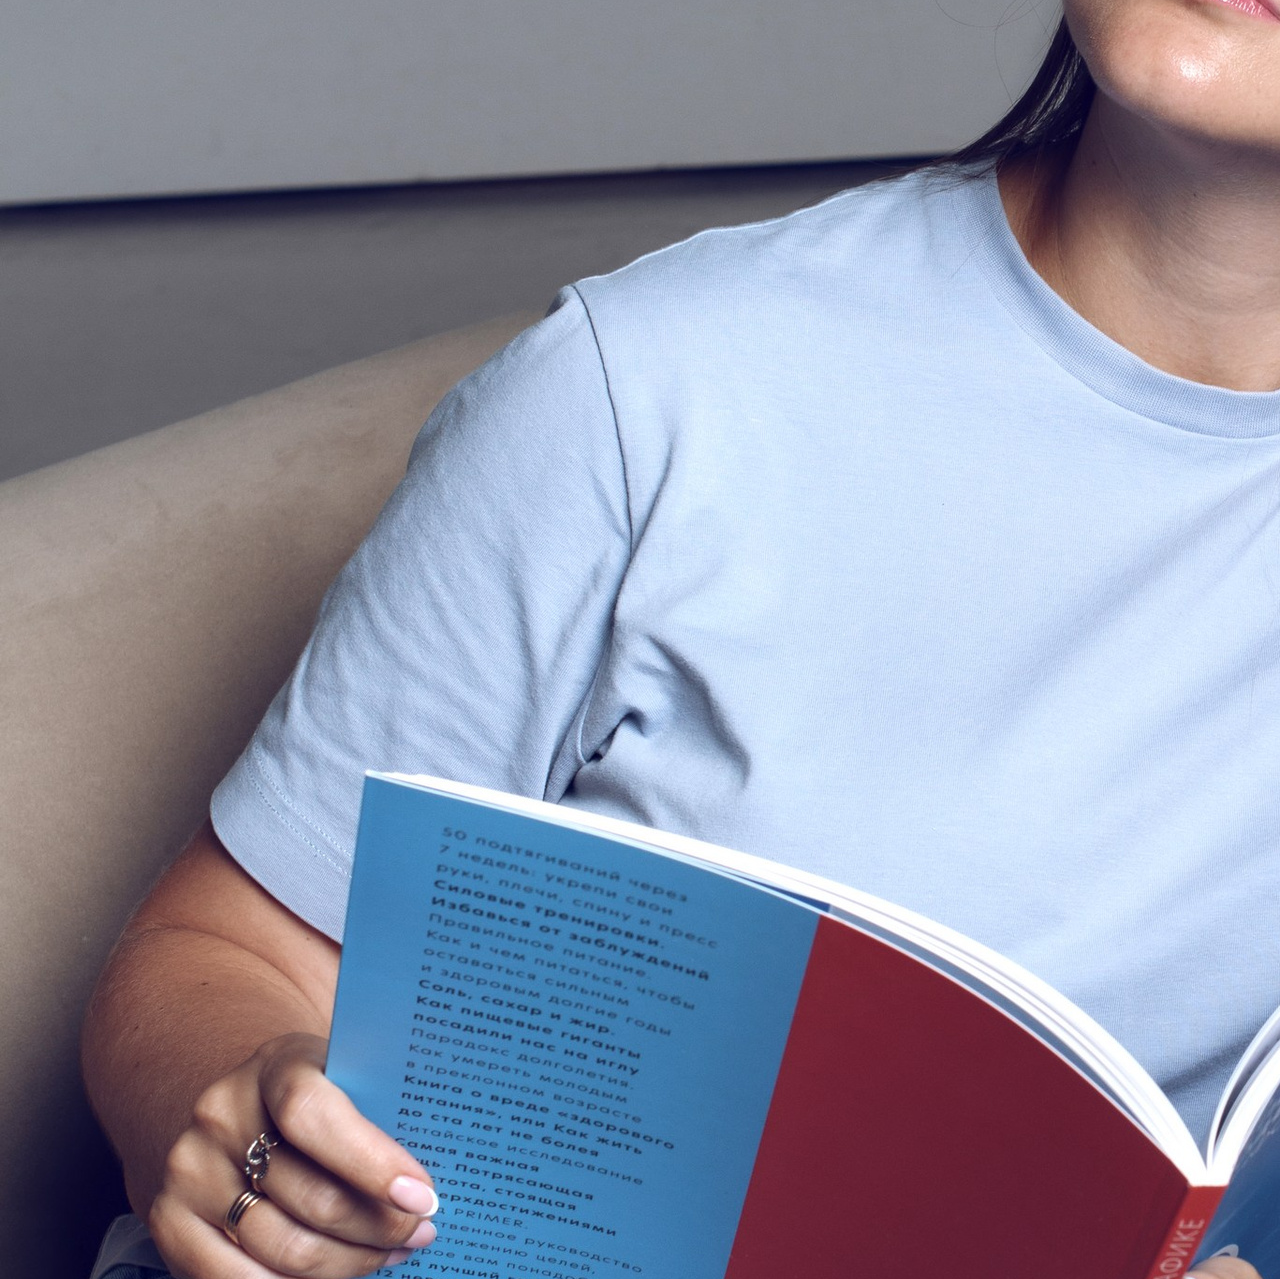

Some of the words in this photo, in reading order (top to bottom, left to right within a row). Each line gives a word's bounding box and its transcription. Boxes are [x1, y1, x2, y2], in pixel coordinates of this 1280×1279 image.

[440, 844, 450, 854] 7
[458, 852, 535, 876] недель:
[545, 873, 617, 898] укрепи
[626, 896, 672, 916] свои
[442, 828, 467, 841] 50
[476, 837, 620, 882] подтягиваний
[628, 878, 688, 903] через
[434, 880, 526, 910] Силовые
[534, 906, 664, 949] тренировки.
[436, 864, 489, 884] руки,
[499, 879, 563, 903] плечи,
[572, 899, 631, 922] спину
[640, 918, 651, 926] и
[659, 924, 717, 948] пресс
[429, 913, 554, 952] Правильное
[563, 948, 650, 979] питание.
[431, 896, 531, 928] Избавься
[539, 925, 561, 936] от
[569, 932, 710, 981] заблуждений
[424, 948, 536, 981] оставаться
[545, 978, 629, 1006] сильным
[426, 930, 461, 946] Как
[470, 942, 481, 950] и
[489, 947, 526, 962] чем
[534, 958, 628, 990] питаться,
[637, 986, 695, 1010] чтобы
[416, 995, 452, 1012] Как
[460, 1007, 553, 1035] пищевые
[561, 1031, 641, 1060] гиганты
[418, 980, 472, 1000] Соль,
[481, 996, 542, 1016] сахар
[550, 1012, 562, 1021] и
[569, 1018, 615, 1036] жир.
[440, 969, 540, 999] здоровым
[548, 996, 618, 1019] долгие
[626, 1017, 671, 1036] годы
[409, 1044, 443, 1058] Как
[452, 1054, 531, 1078] умереть
[539, 1075, 627, 1104] молодым
[412, 1028, 509, 1056] Парадокс
[517, 1054, 633, 1090] долголетия.
[413, 1013, 513, 1041] посадили
[520, 1038, 556, 1052] нас
[564, 1048, 588, 1060] на
[596, 1057, 639, 1076] иглу
[401, 1092, 502, 1119] питания»,
[510, 1115, 546, 1128] или
[554, 1124, 589, 1140] Как
[596, 1136, 642, 1155] жить
[404, 1074, 463, 1094] Книга
[470, 1090, 482, 1098] о
[490, 1094, 550, 1114] вреде
[557, 1112, 674, 1150] «здорового
[424, 1065, 544, 1097] преклонном
[553, 1094, 642, 1124] возрасте
[397, 1122, 499, 1148] Китайское
[507, 1145, 643, 1185] исследование
[398, 1108, 423, 1118] до
[430, 1114, 463, 1126] ста
[470, 1122, 503, 1134] лет
[510, 1130, 533, 1141] не
[541, 1136, 600, 1157] болея
[465, 1152, 540, 1173] важная
[455, 1163, 594, 1201] Потрясающая
[494, 1188, 576, 1211] стоящая
[454, 1208, 528, 1229] PRIMER.
[428, 1263, 500, 1279] лучший
[464, 1255, 498, 1266] вам
[524, 1238, 642, 1273] руководство
[536, 1255, 595, 1274] целей,
